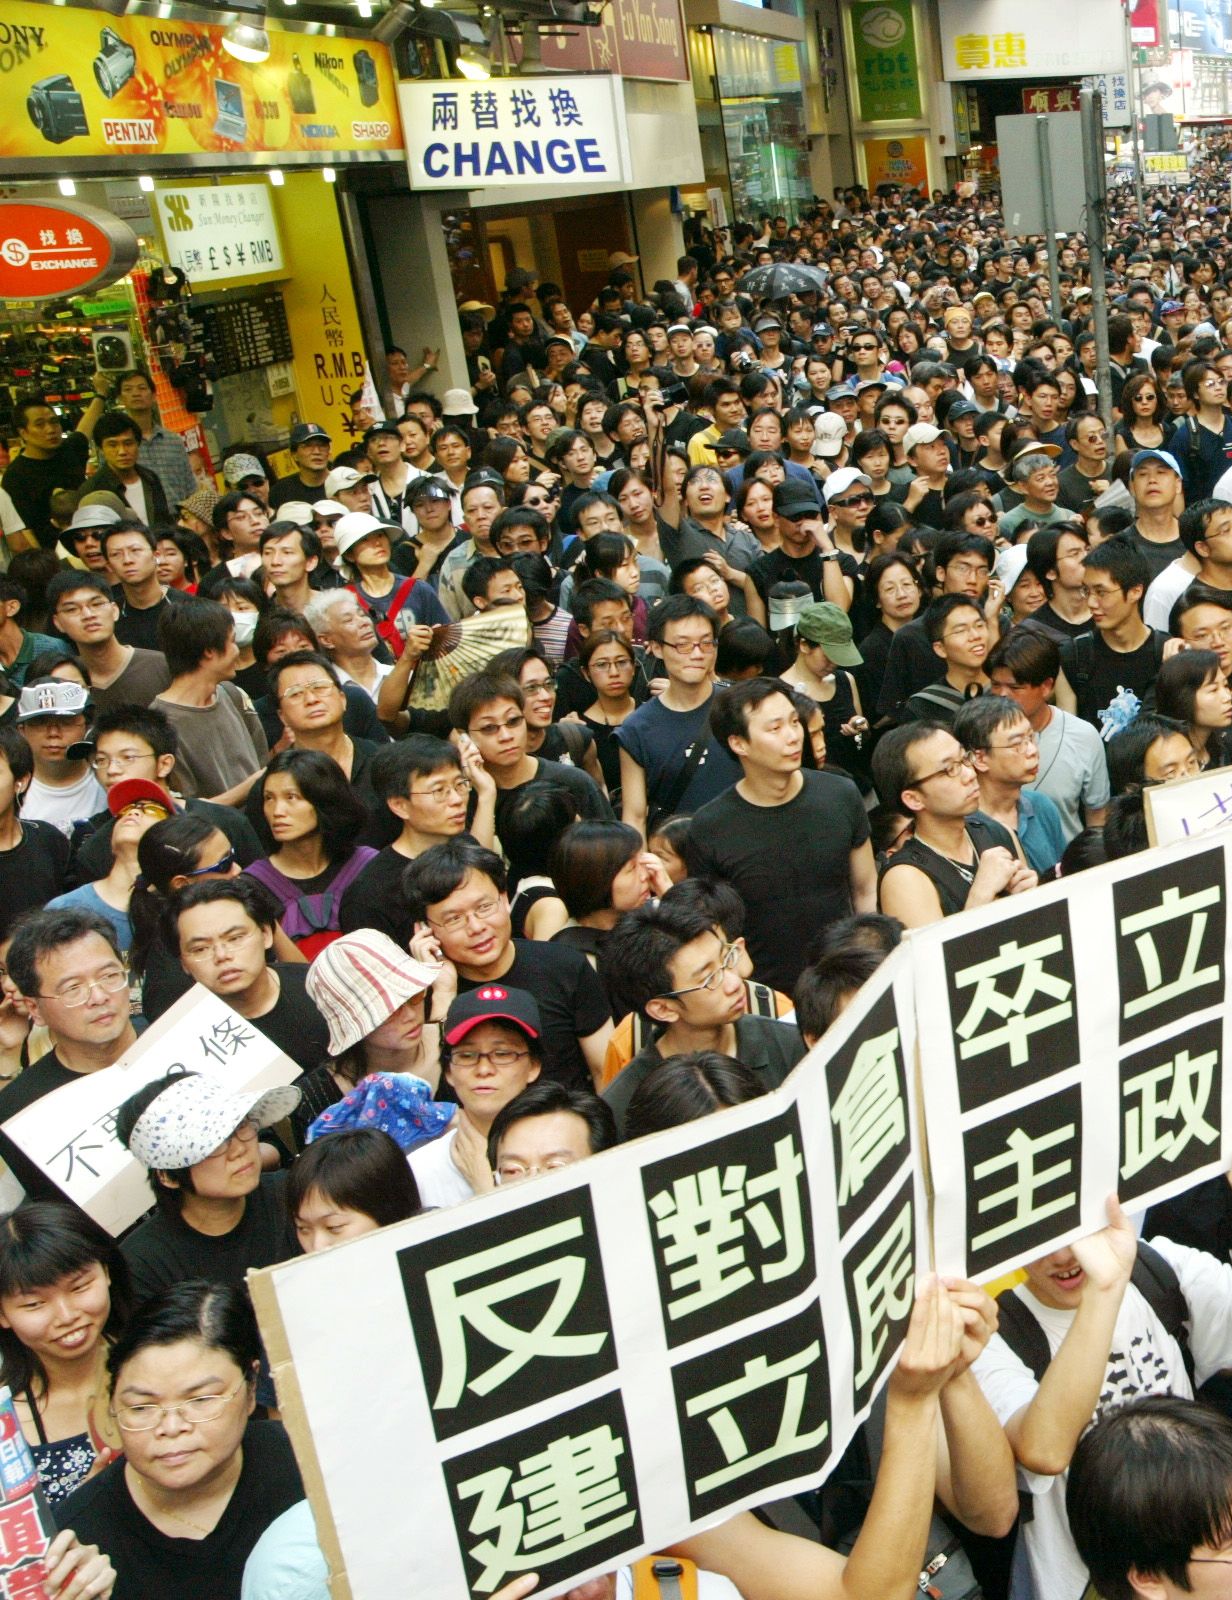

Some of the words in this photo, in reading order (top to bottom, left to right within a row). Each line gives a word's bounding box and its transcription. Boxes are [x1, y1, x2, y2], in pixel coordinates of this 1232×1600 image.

[314, 52, 344, 69] Nikon
[432, 88, 583, 131] 兩替找換
[104, 122, 155, 141] PENTAX
[353, 123, 389, 138] SHARP
[423, 139, 606, 178] CHANGE
[39, 228, 84, 246] 找換
[250, 240, 273, 264] RMB
[30, 258, 98, 270] EXCHANGE
[320, 283, 344, 347] 人民幣
